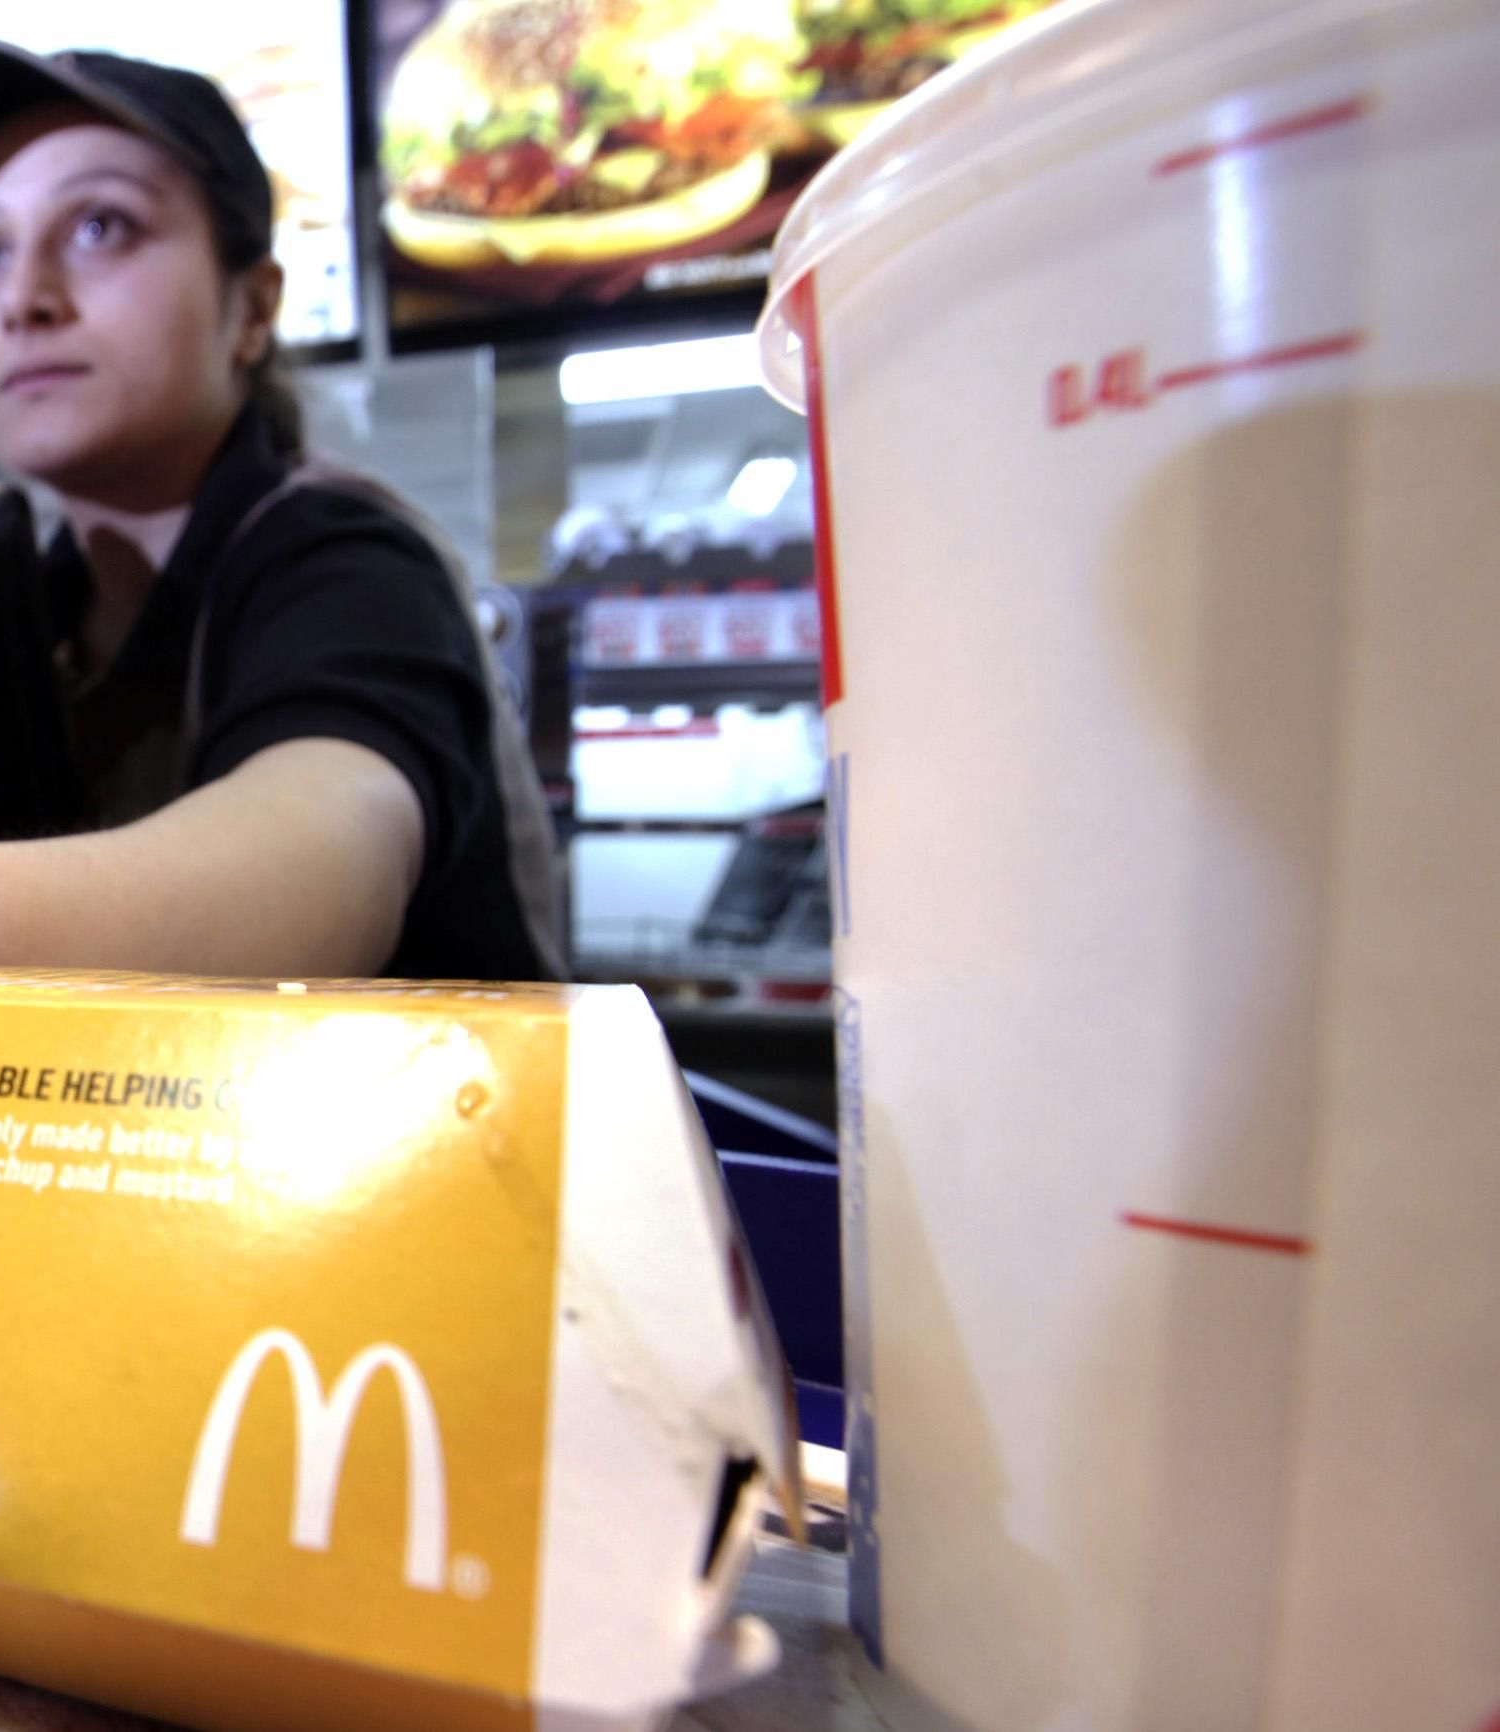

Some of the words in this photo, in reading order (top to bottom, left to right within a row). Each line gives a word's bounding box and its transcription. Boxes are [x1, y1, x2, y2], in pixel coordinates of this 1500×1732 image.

[60, 1070, 204, 1111] HELPING
[31, 1121, 104, 1153] made
[109, 1122, 194, 1160] better
[200, 1131, 236, 1171] by
[57, 1162, 111, 1193] and
